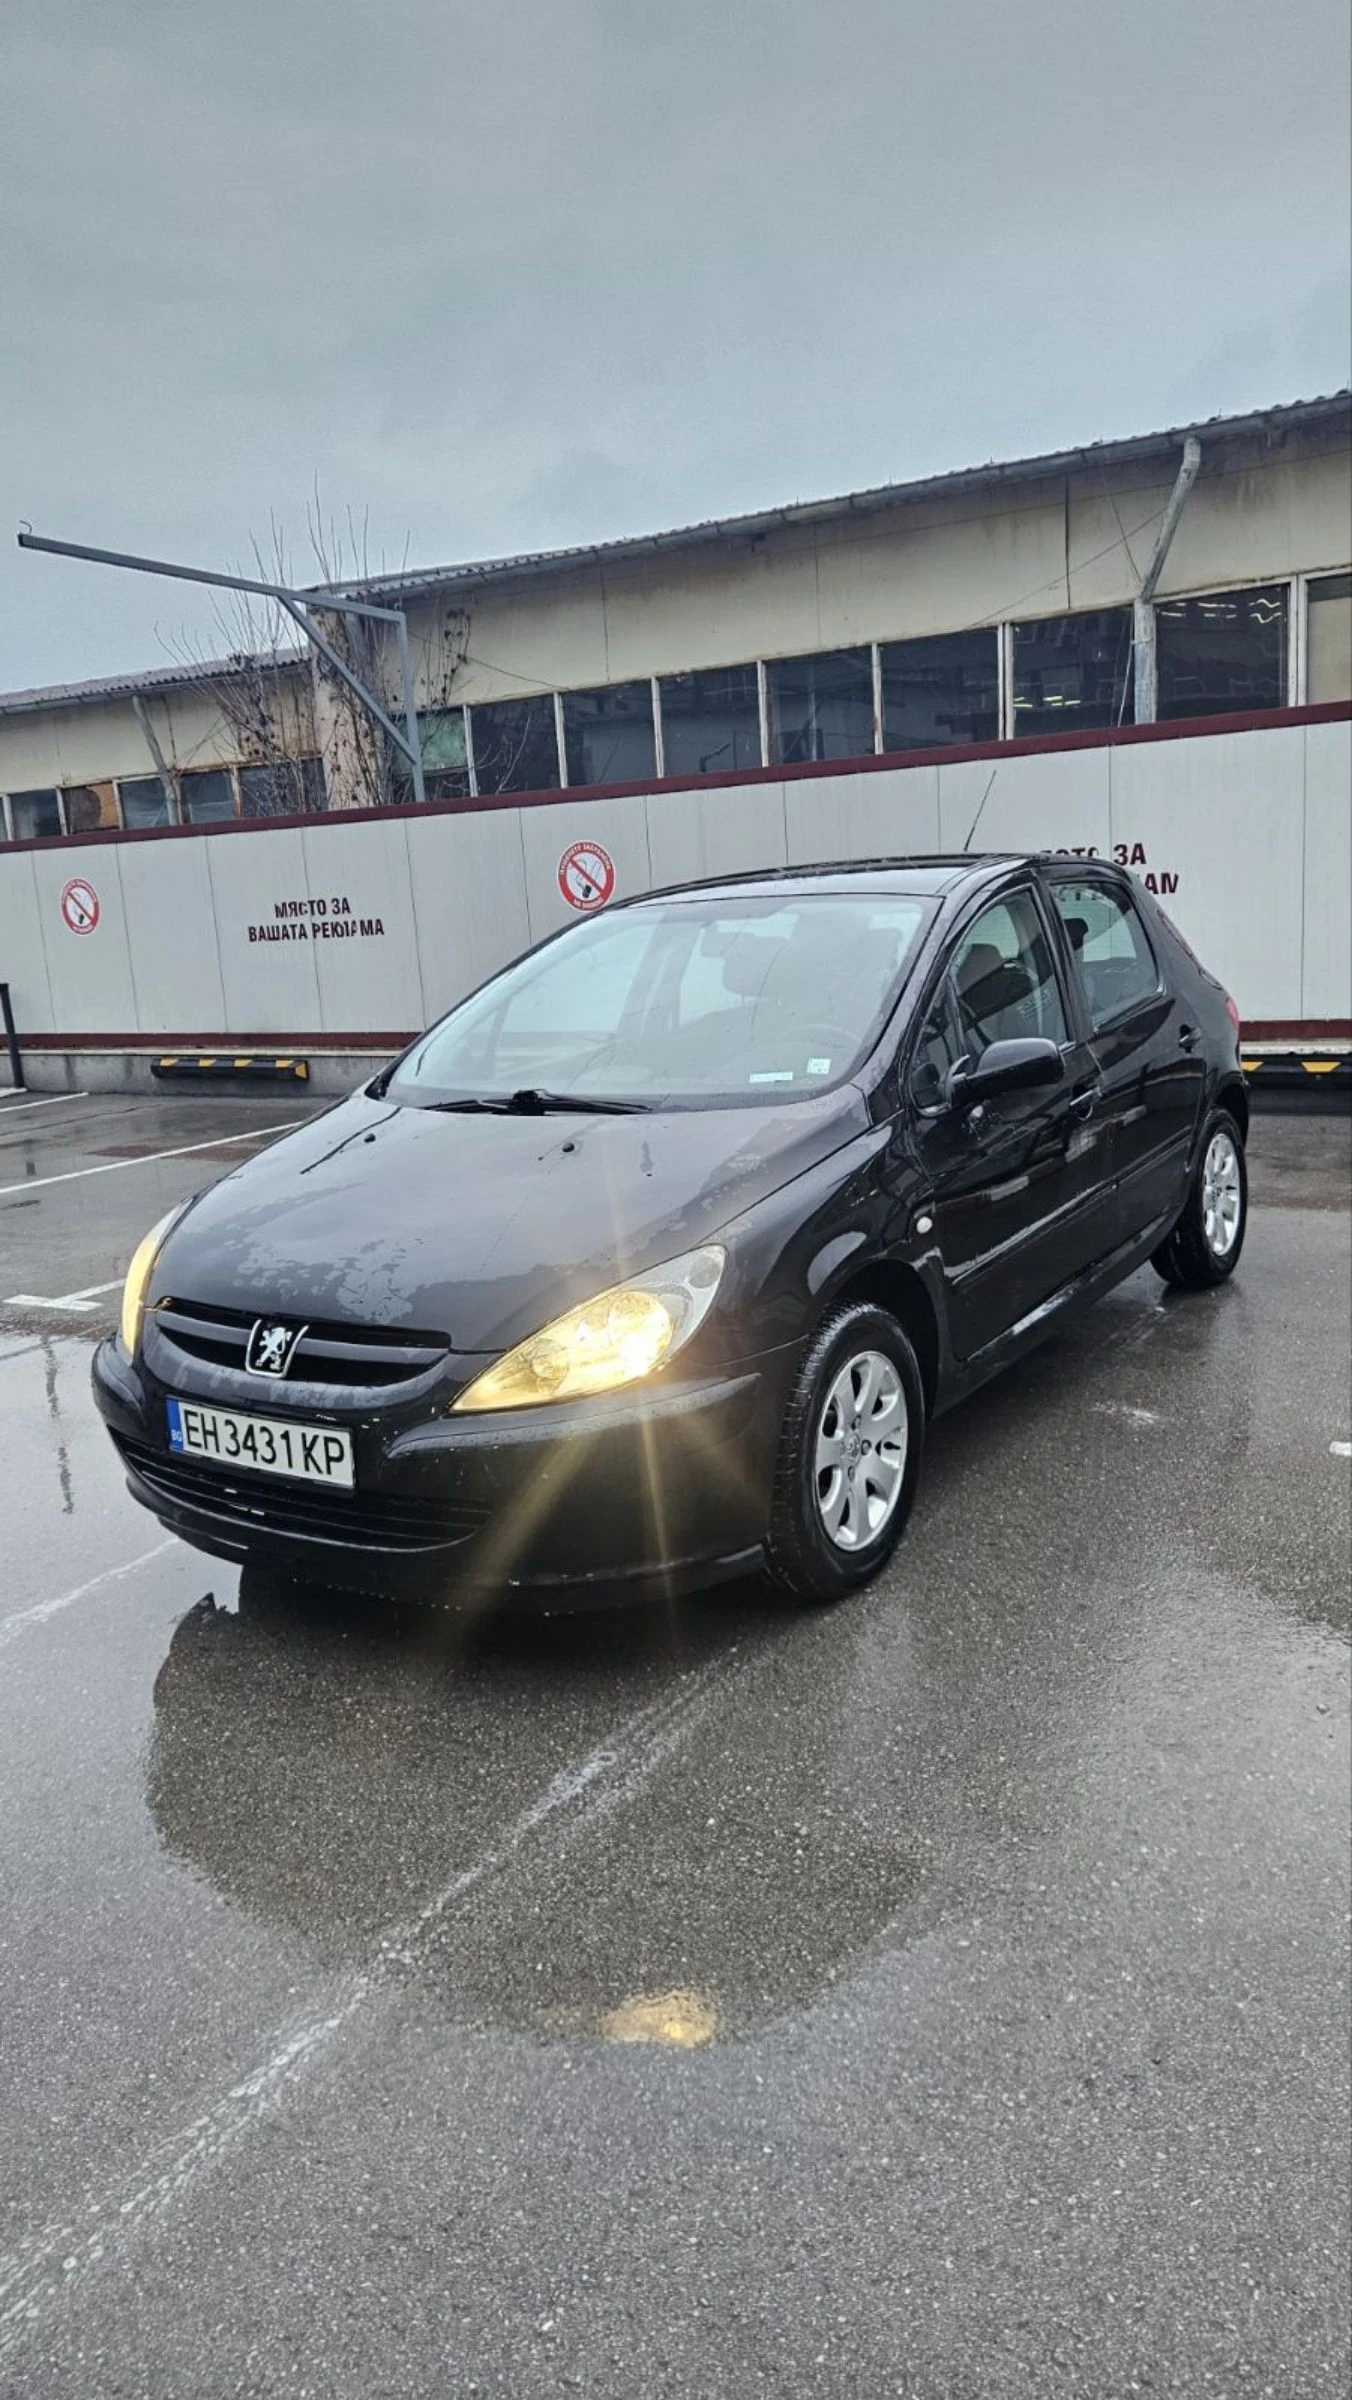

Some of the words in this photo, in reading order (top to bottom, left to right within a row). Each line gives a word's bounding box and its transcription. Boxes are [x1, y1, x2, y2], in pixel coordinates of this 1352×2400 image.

[1113, 843, 1147, 866] ЗА
[274, 899, 327, 918] МЯСТО
[331, 897, 351, 915] ЗА
[248, 923, 308, 942] ВАШАТА
